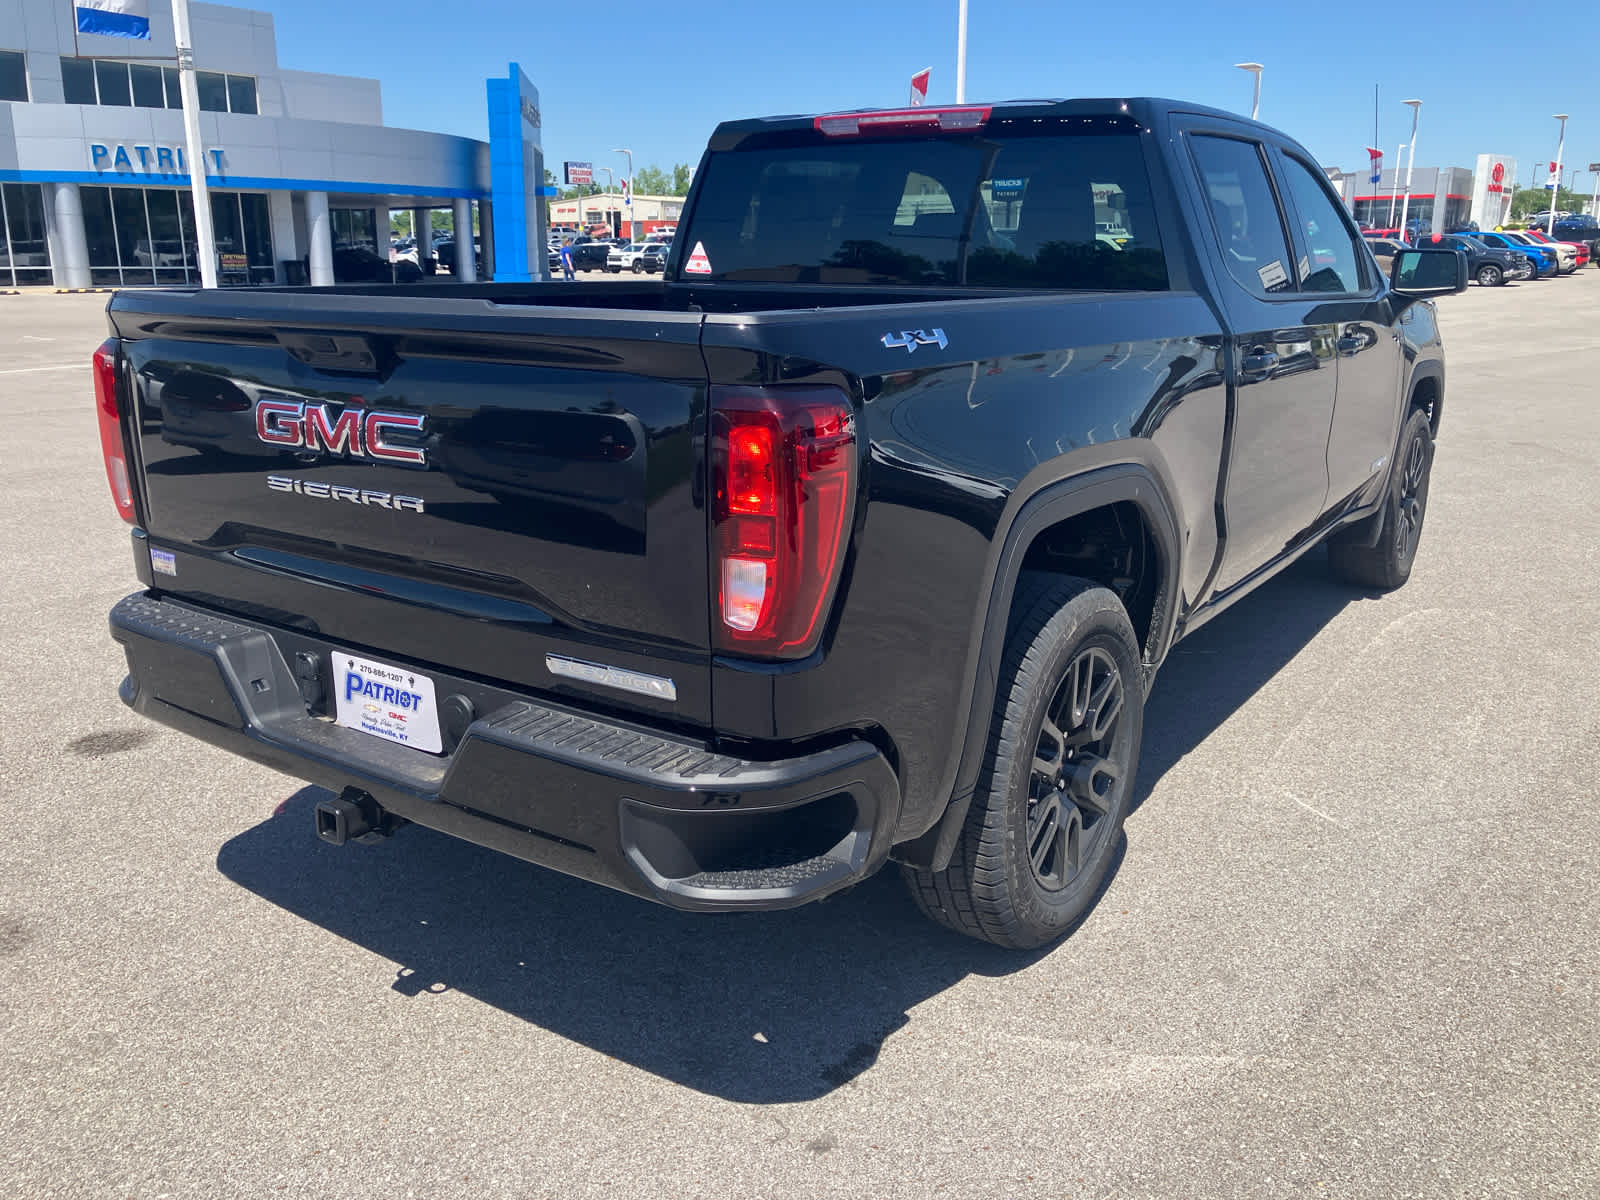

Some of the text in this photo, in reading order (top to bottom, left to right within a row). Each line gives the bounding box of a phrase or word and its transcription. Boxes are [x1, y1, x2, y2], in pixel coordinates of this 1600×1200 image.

[91, 144, 225, 170] PATRIT
[256, 400, 425, 465] GMC
[267, 475, 424, 513] SIERRA
[346, 671, 422, 711] PATRIOT
